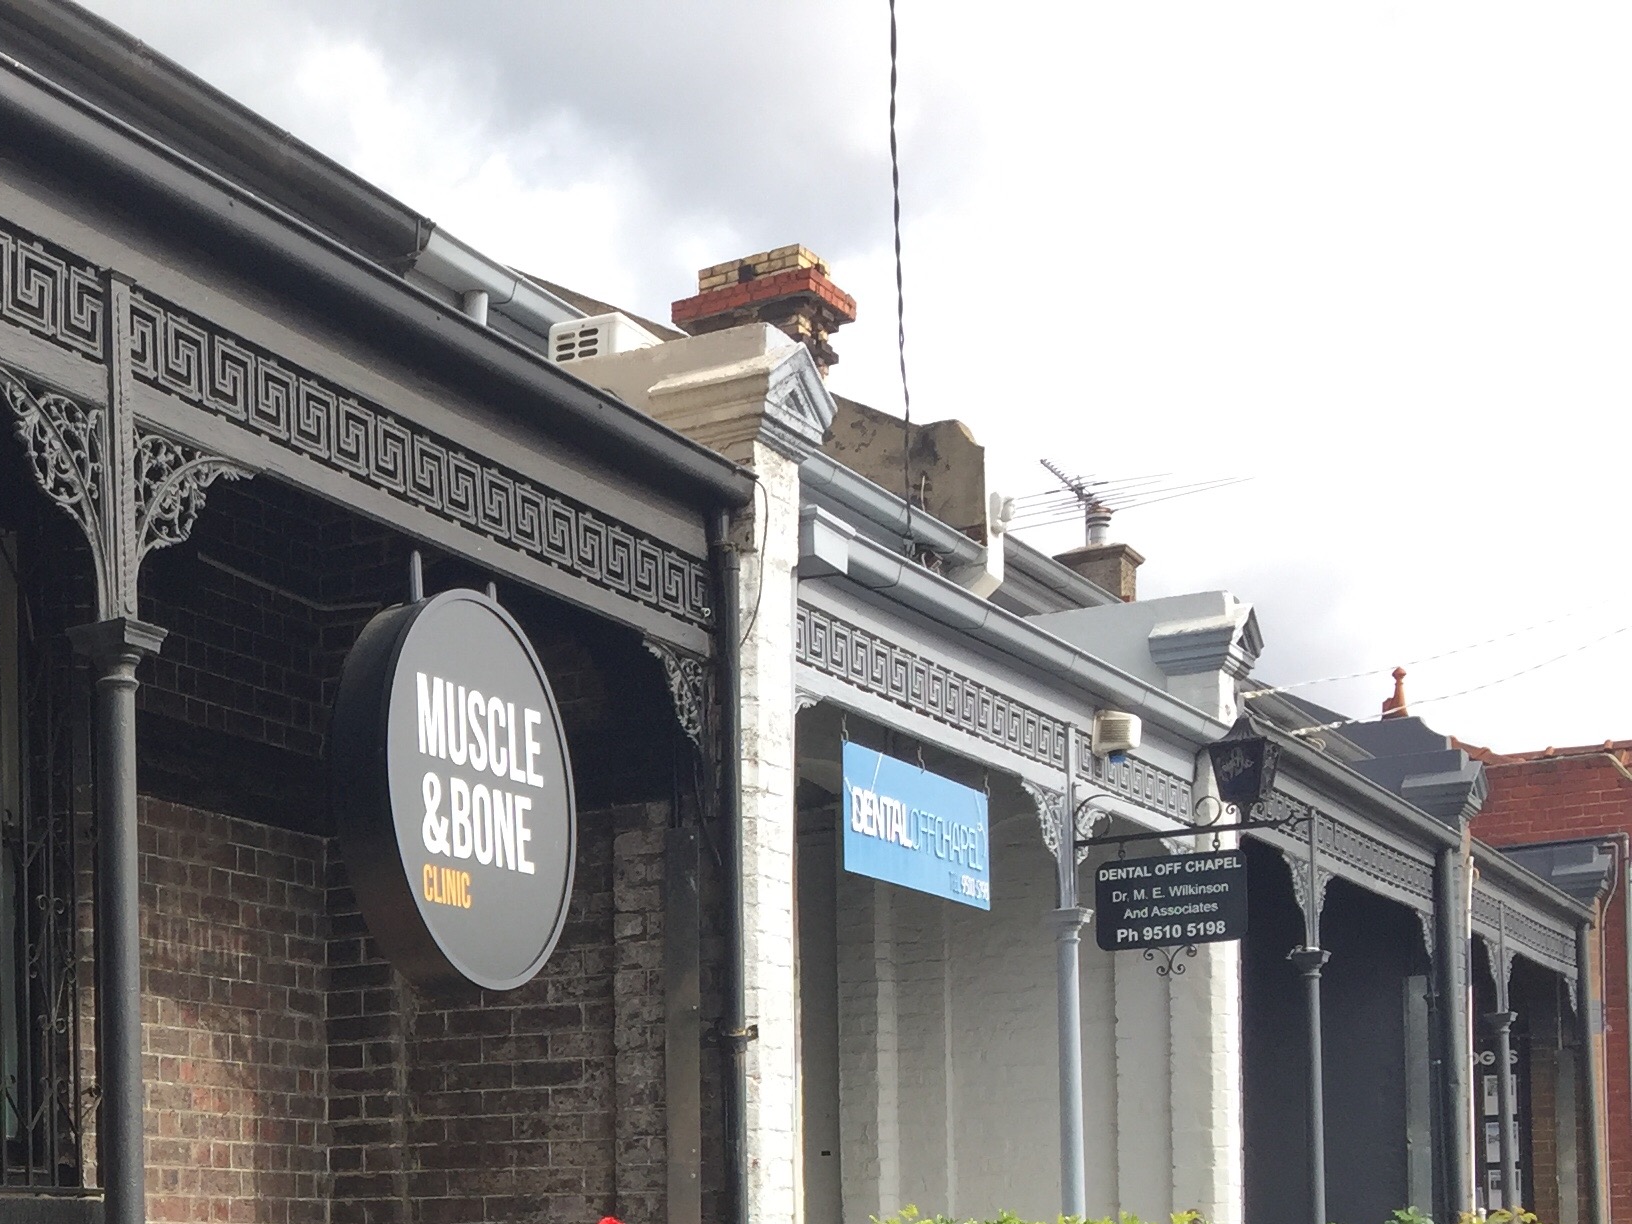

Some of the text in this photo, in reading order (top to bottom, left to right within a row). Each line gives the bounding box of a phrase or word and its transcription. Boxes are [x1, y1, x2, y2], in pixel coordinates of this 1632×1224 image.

[416, 672, 544, 789] MUSCLE
[1099, 857, 1242, 882] DENTAL OFF CHAPEL
[423, 863, 472, 910] CLINIC
[1112, 882, 1229, 903] Dr. M. E. Wilkinson
[1123, 902, 1219, 919] And Associates
[1117, 920, 1226, 942] Ph 9510 5198
